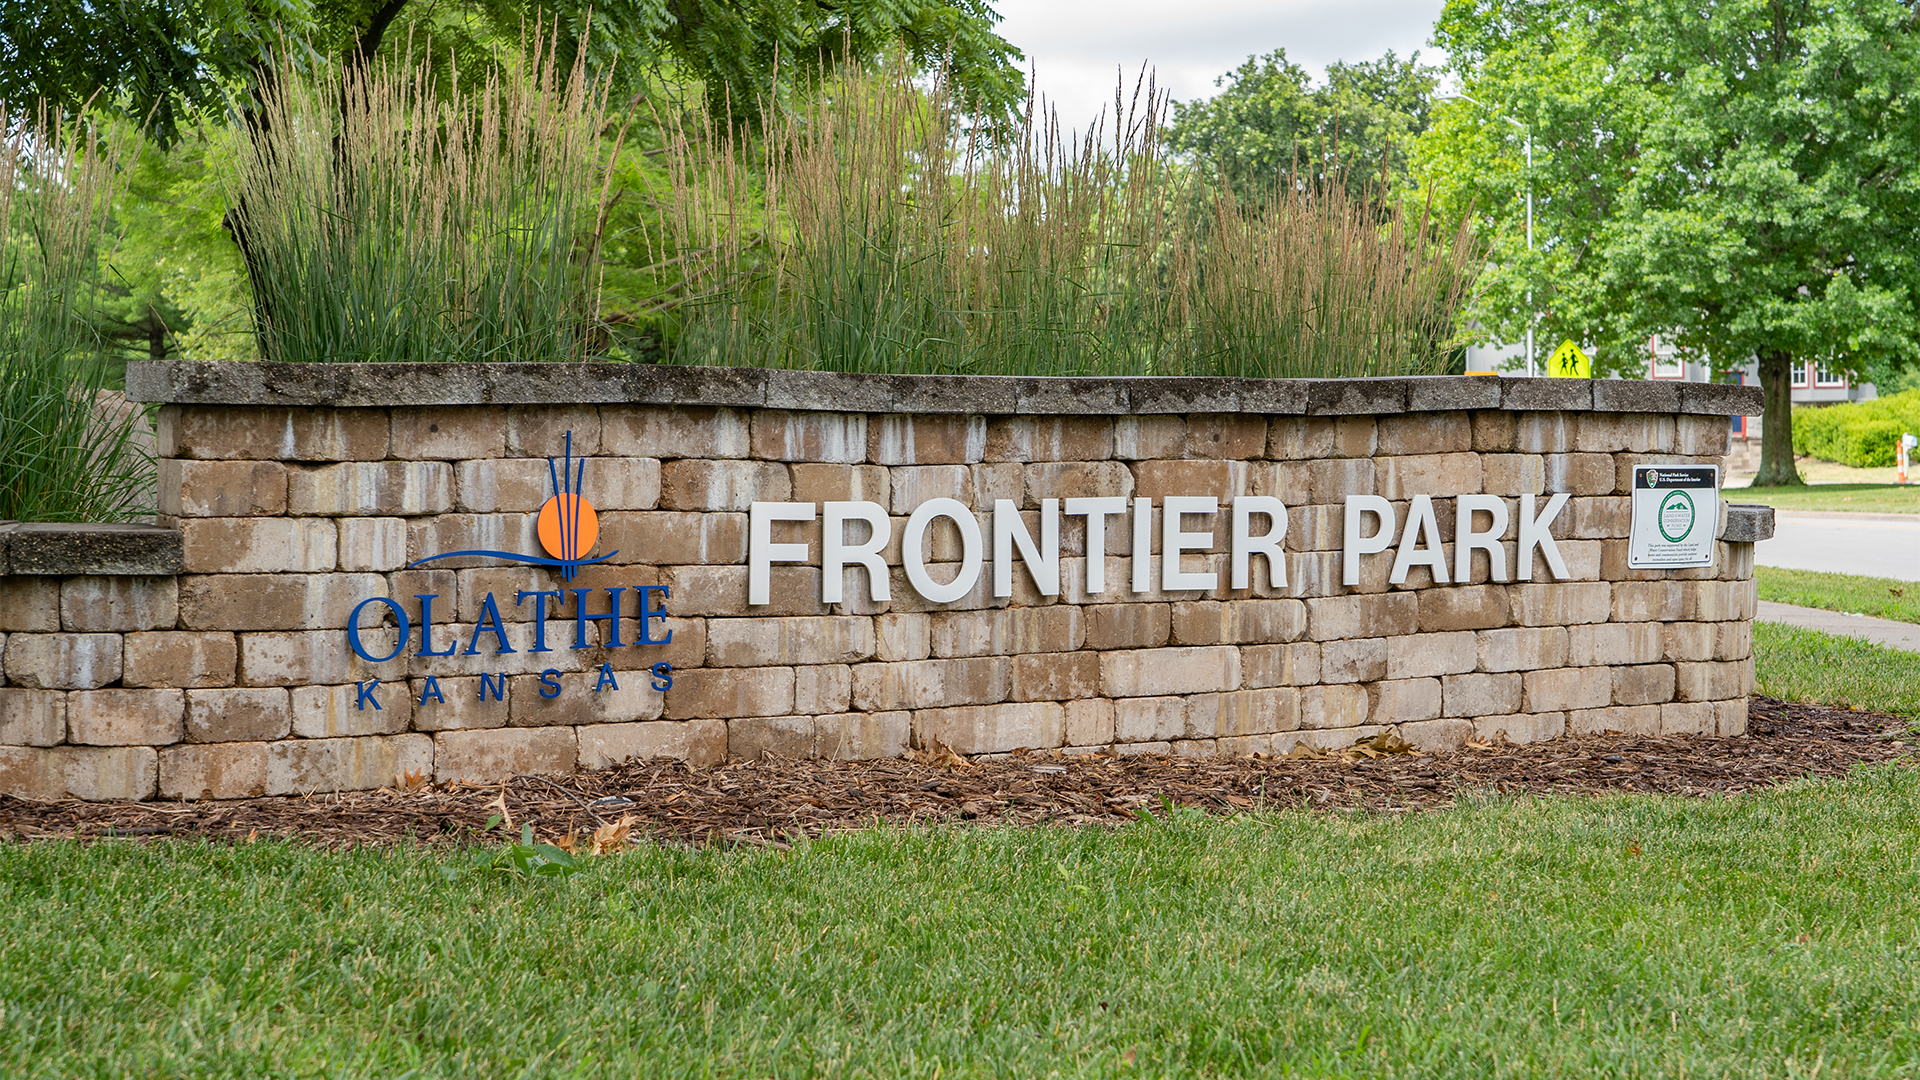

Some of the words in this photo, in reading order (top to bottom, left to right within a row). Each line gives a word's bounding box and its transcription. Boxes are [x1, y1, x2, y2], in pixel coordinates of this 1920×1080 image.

[748, 496, 1288, 605] FRONTIER
[1343, 493, 1571, 586] PARK
[348, 585, 672, 662] OLATHE
[356, 662, 674, 711] KANSAS
